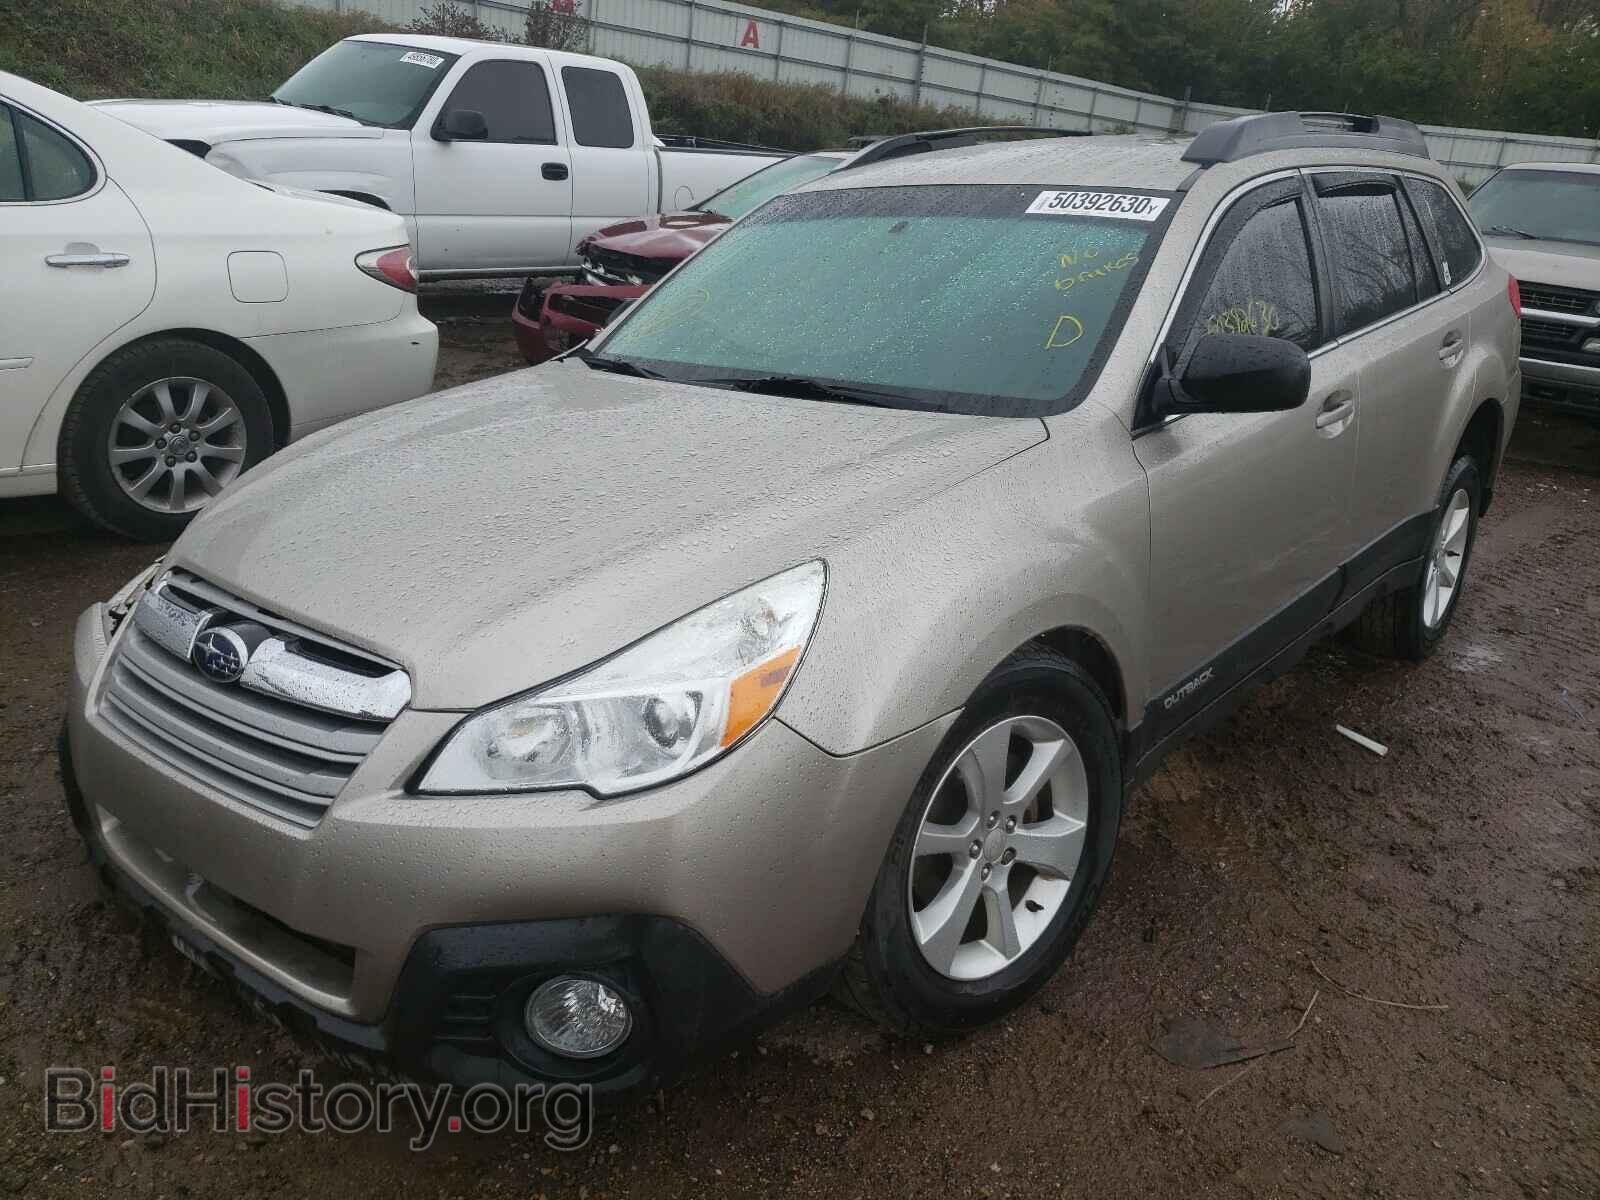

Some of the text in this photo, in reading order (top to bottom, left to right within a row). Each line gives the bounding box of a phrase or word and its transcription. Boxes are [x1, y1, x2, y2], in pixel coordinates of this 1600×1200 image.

[740, 19, 760, 49] A
[1044, 314, 1084, 350] D
[1163, 666, 1215, 710] OUTBACK
